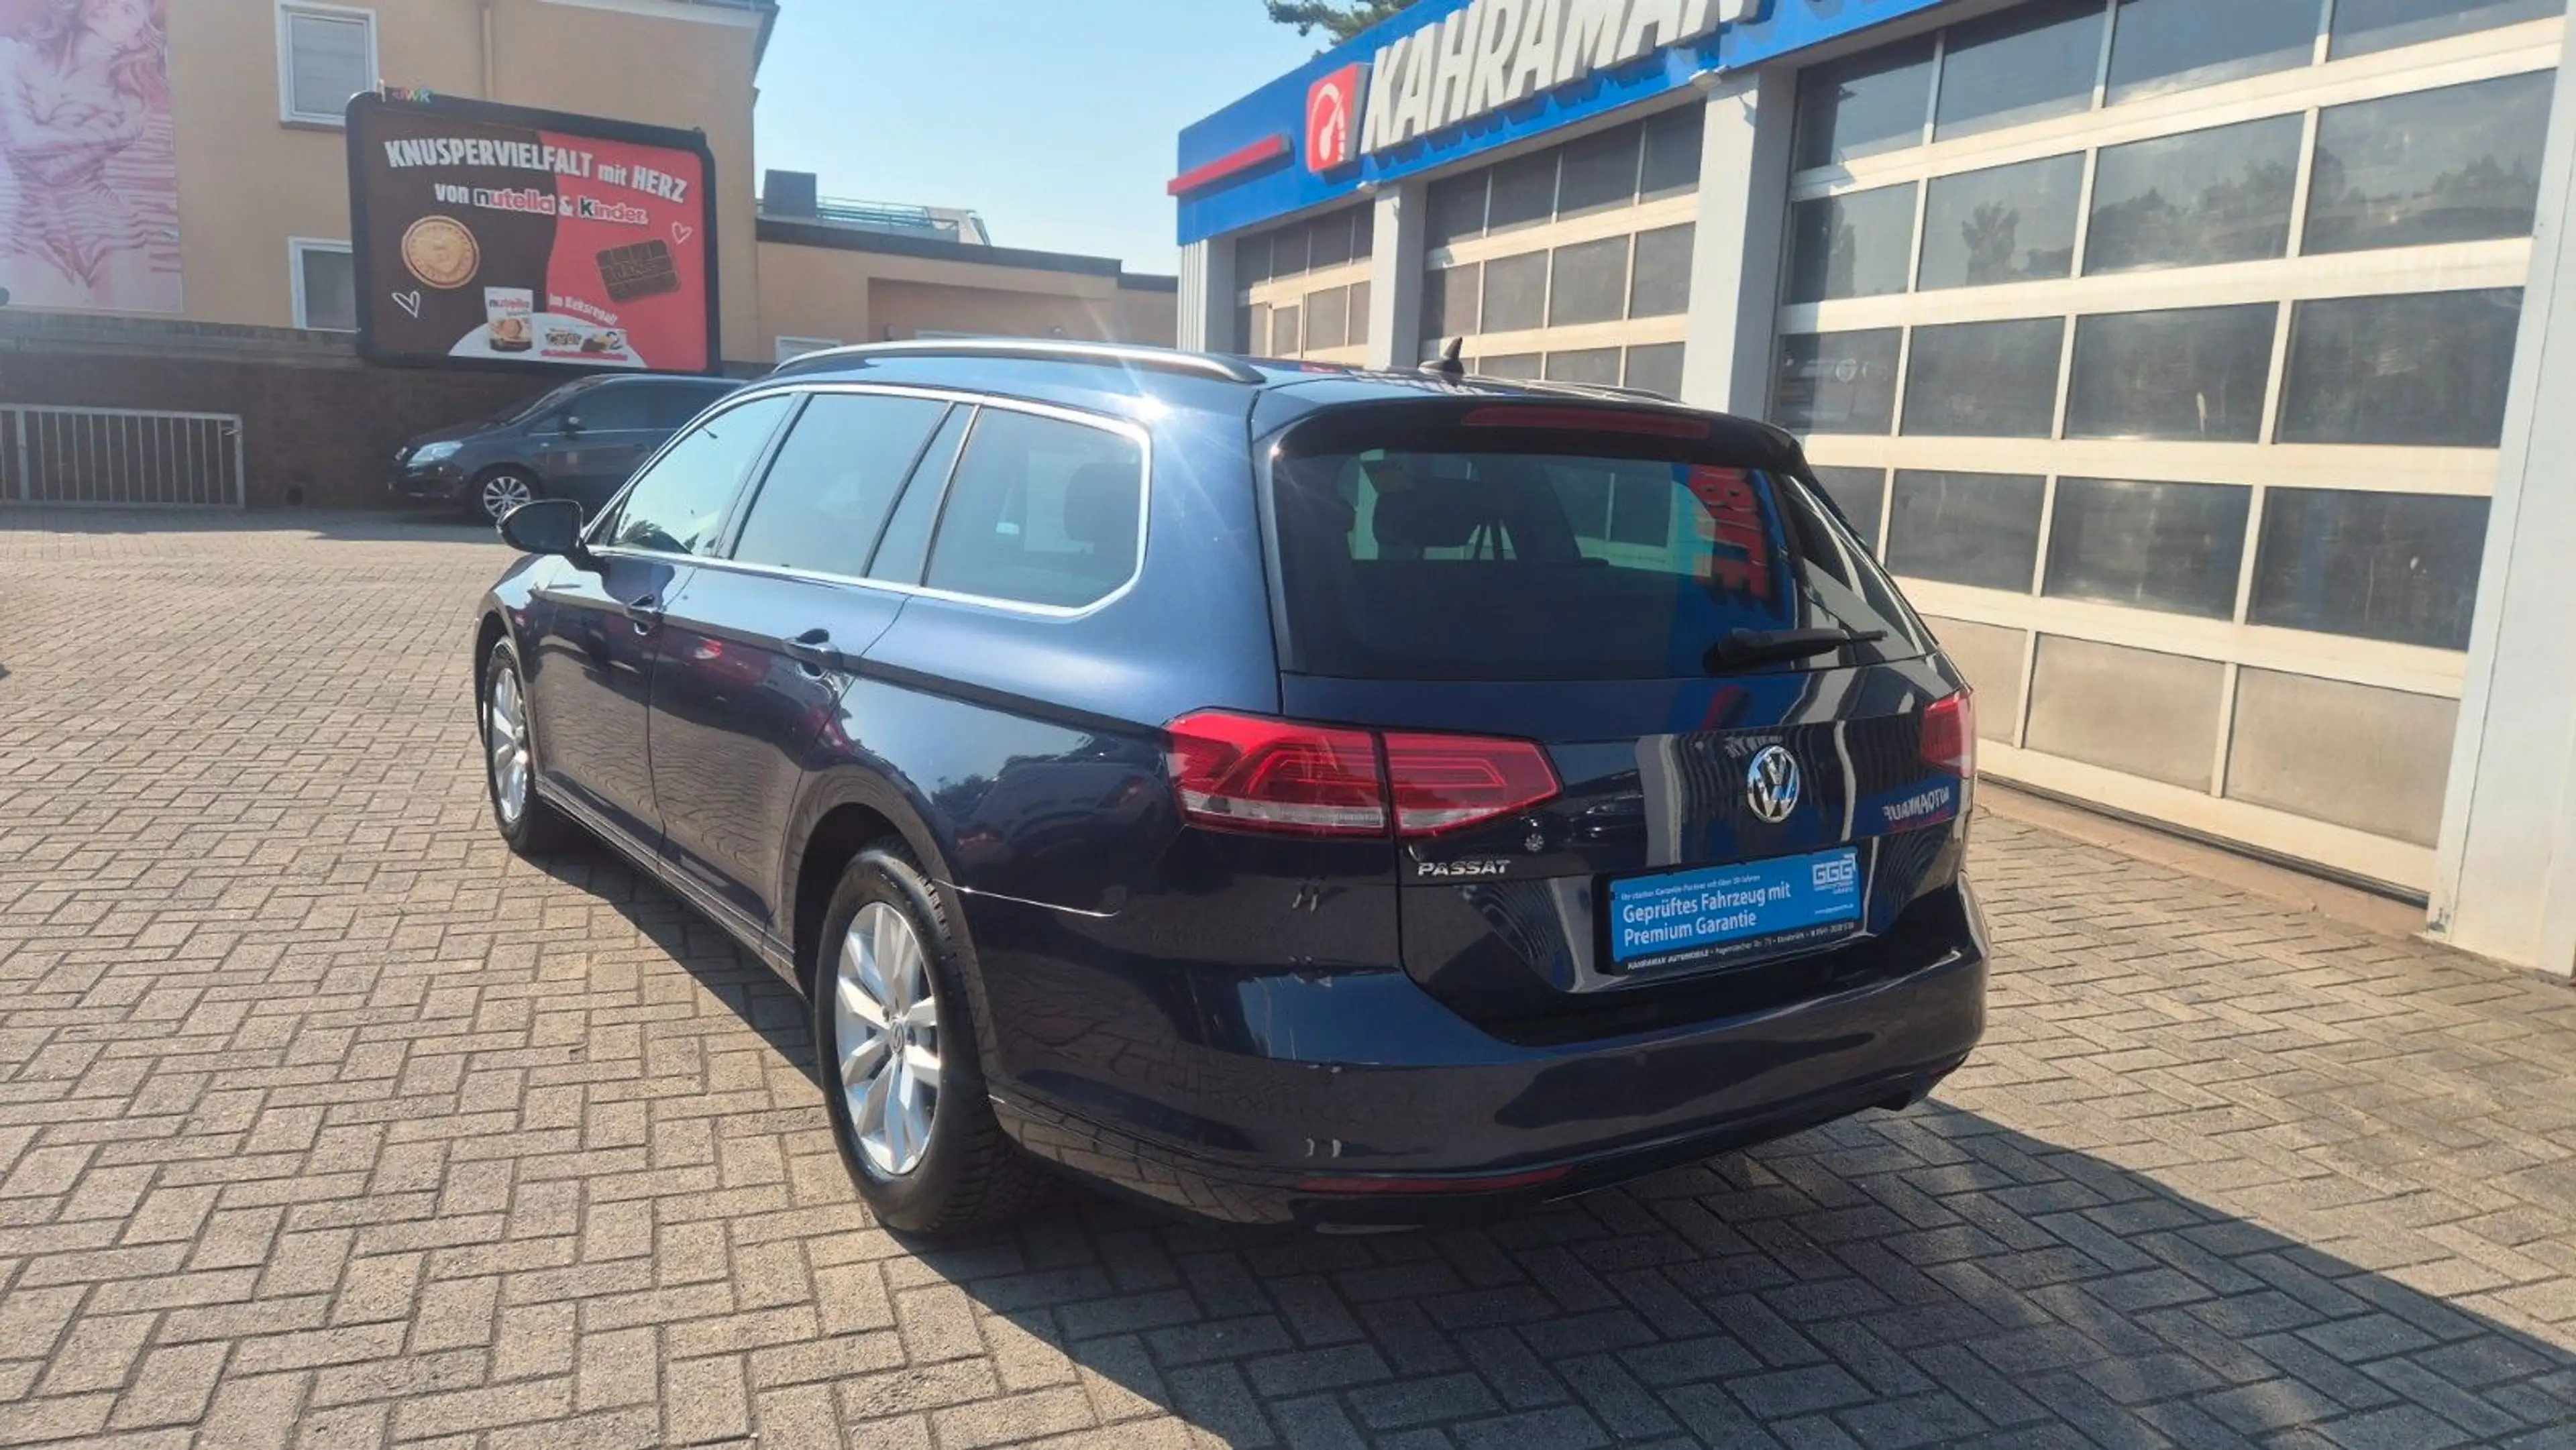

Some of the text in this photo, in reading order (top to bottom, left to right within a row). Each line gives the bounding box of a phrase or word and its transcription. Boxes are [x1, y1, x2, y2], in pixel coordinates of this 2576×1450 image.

[1360, 0, 1746, 154] KAHRAM
[385, 137, 687, 203] KNUSPERVIELFALT mit HERZ
[473, 188, 555, 215] nutella
[559, 197, 574, 217] &
[1417, 859, 1511, 877] PASSAT
[1813, 860, 1855, 885] GGG
[1623, 896, 1698, 925] Geprüftes
[1701, 886, 1766, 910] Fahrzeug
[1768, 881, 1791, 900] mit
[1624, 910, 1758, 948] Premium Garantie
